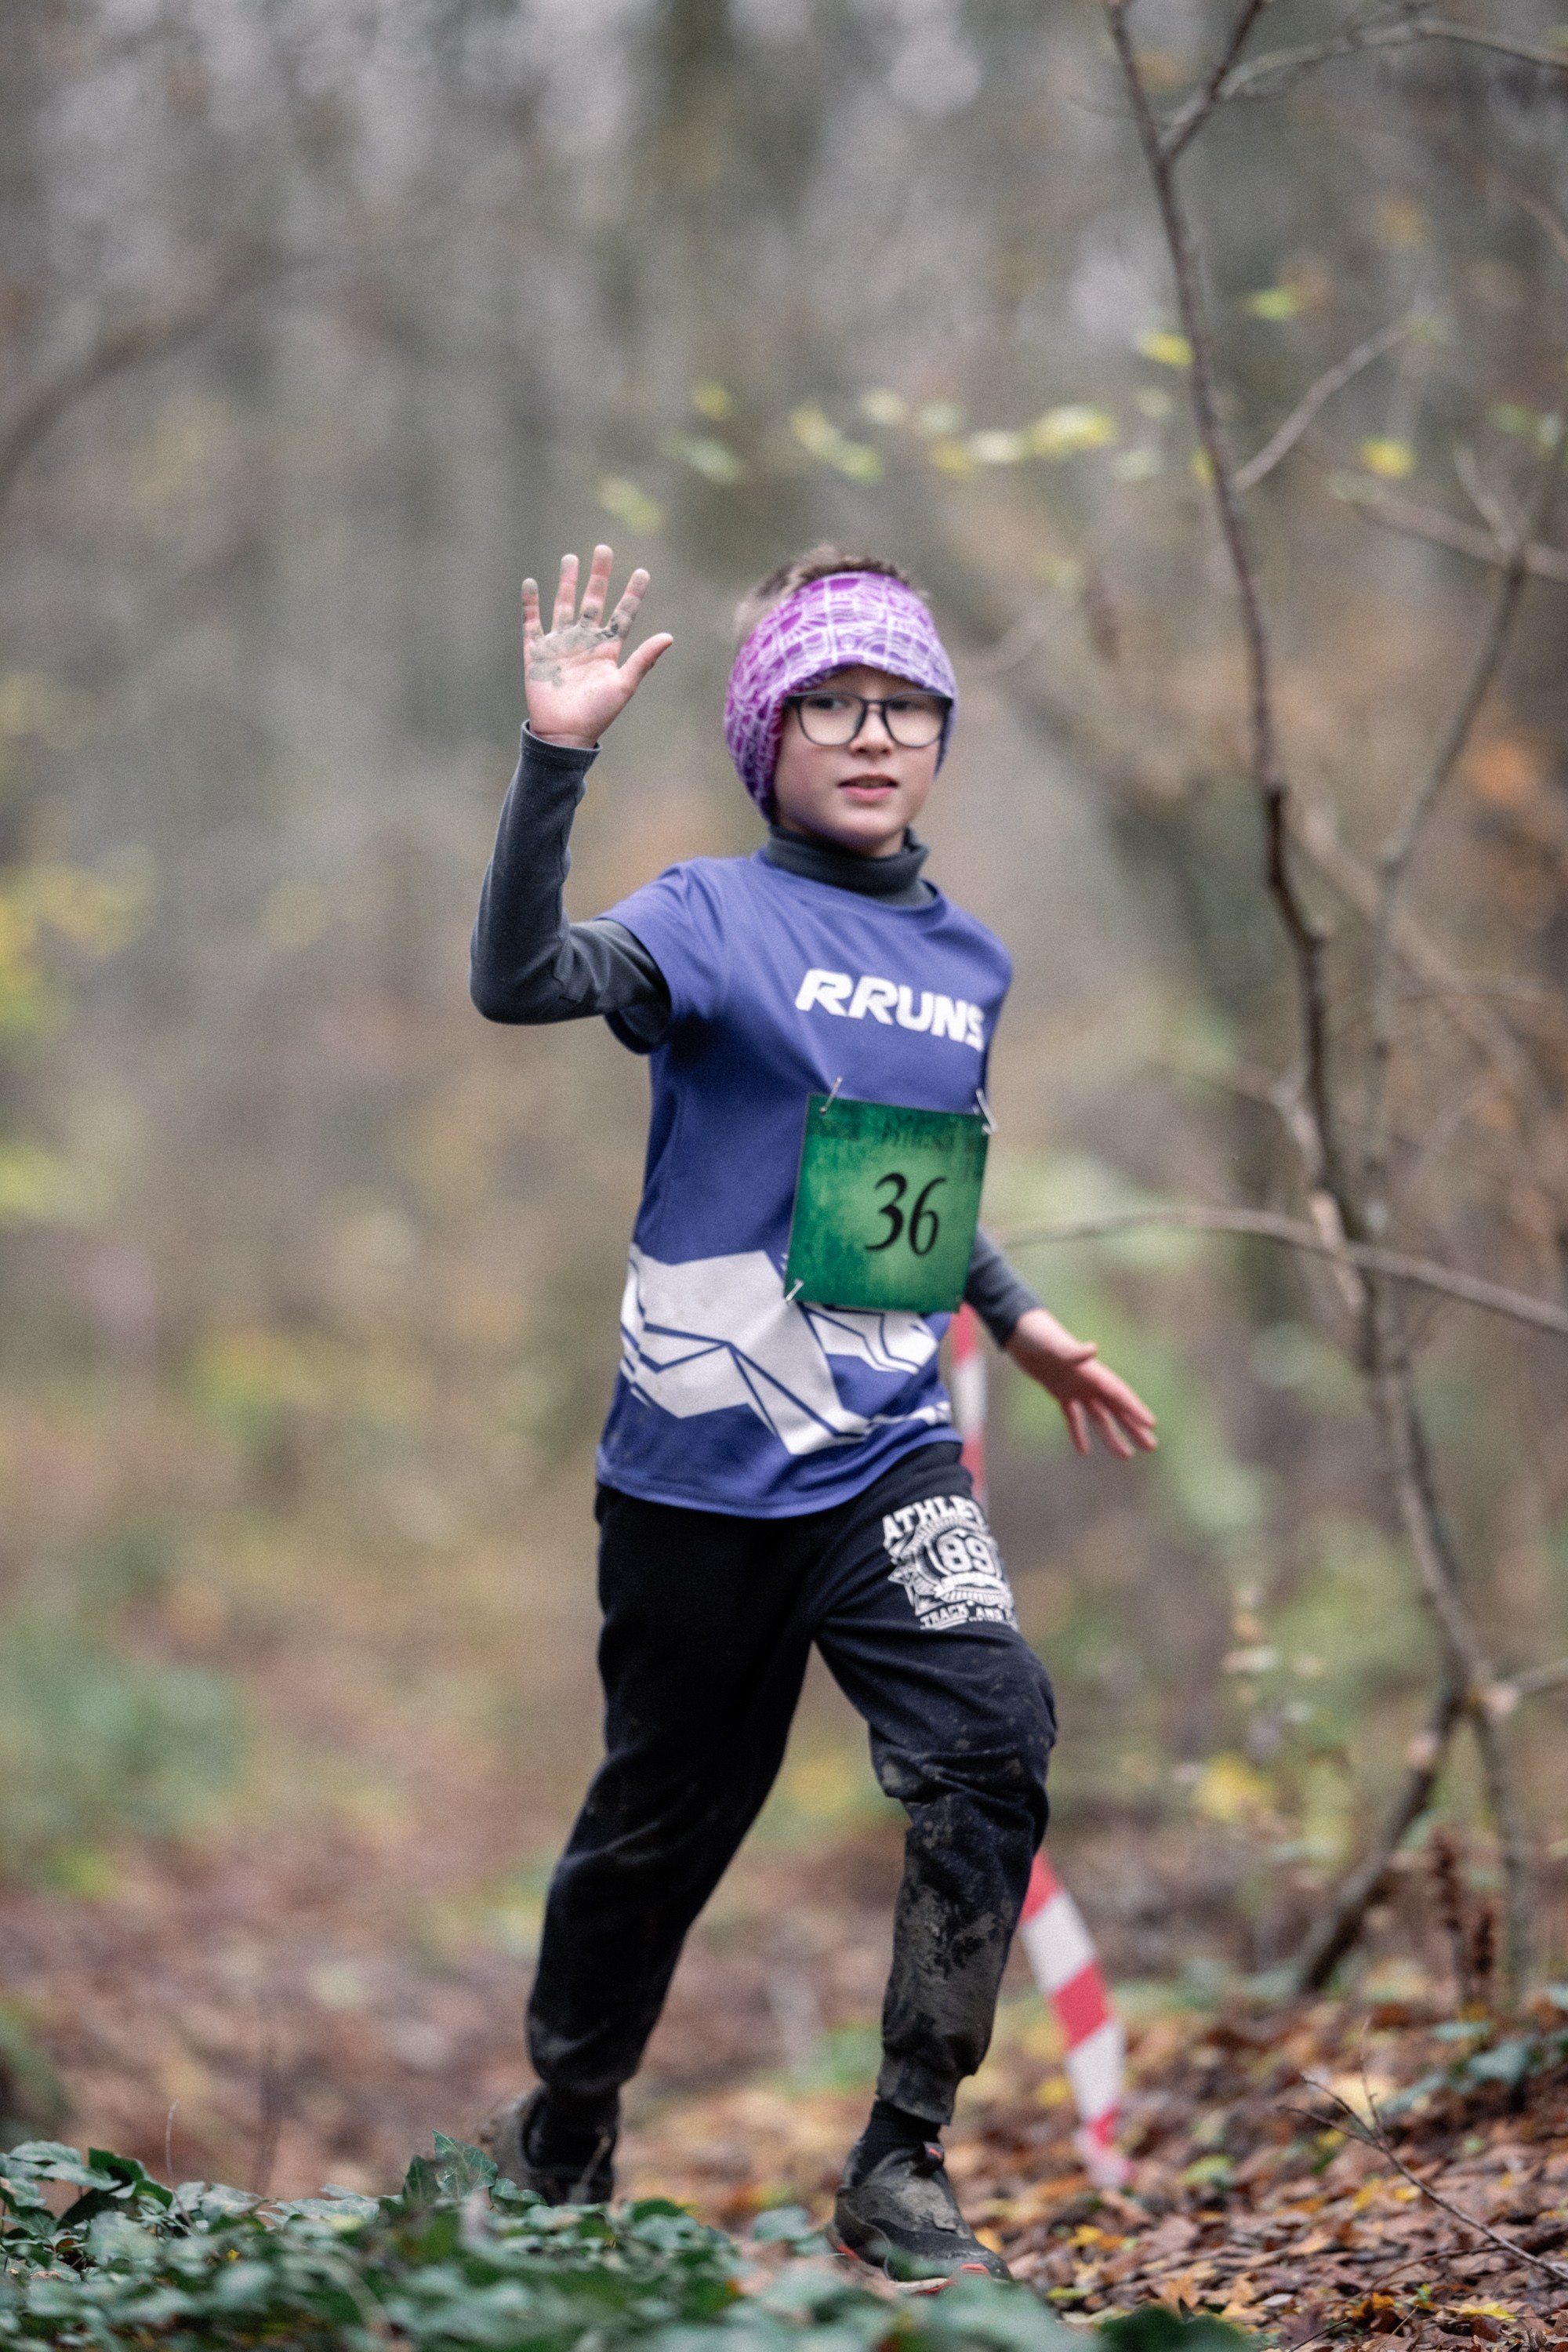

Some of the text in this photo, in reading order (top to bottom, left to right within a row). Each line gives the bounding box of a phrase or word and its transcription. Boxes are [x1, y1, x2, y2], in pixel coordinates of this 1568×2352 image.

[795, 969, 984, 1052] RRUNS
[865, 1173, 946, 1255] 36
[937, 1534, 996, 1575] 89
